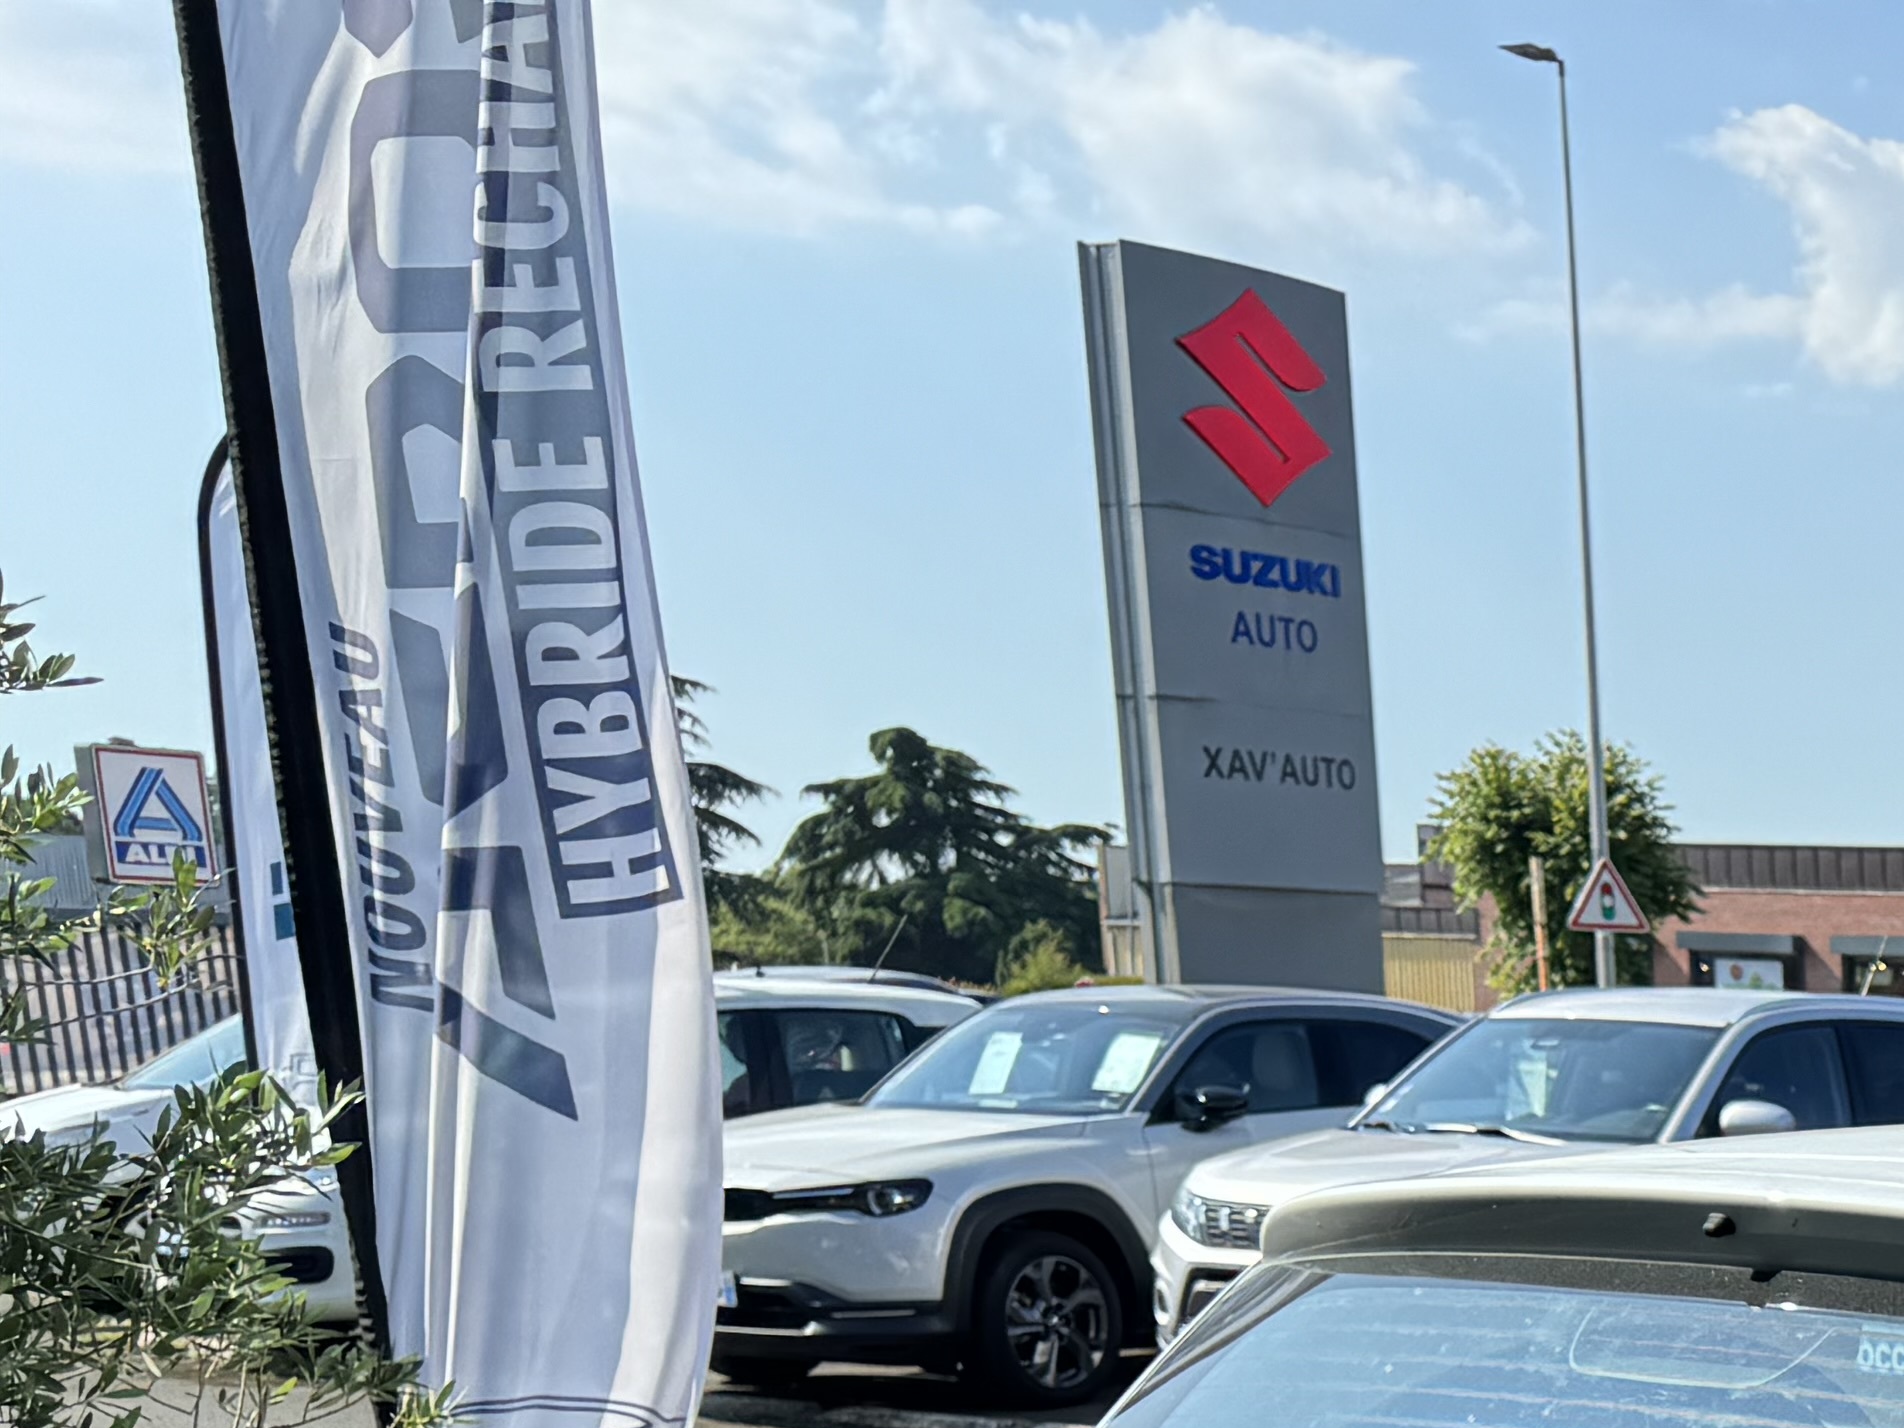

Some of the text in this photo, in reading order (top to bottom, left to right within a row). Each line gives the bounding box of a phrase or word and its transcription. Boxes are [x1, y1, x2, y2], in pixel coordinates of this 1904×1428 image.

[473, 0, 673, 903] HYBRIDE RECHA
[1189, 544, 1341, 598] SUZUKI
[1231, 610, 1318, 653] AUTO
[1202, 745, 1356, 791] XAV'AUTO
[328, 620, 436, 1010] NOUVEAU
